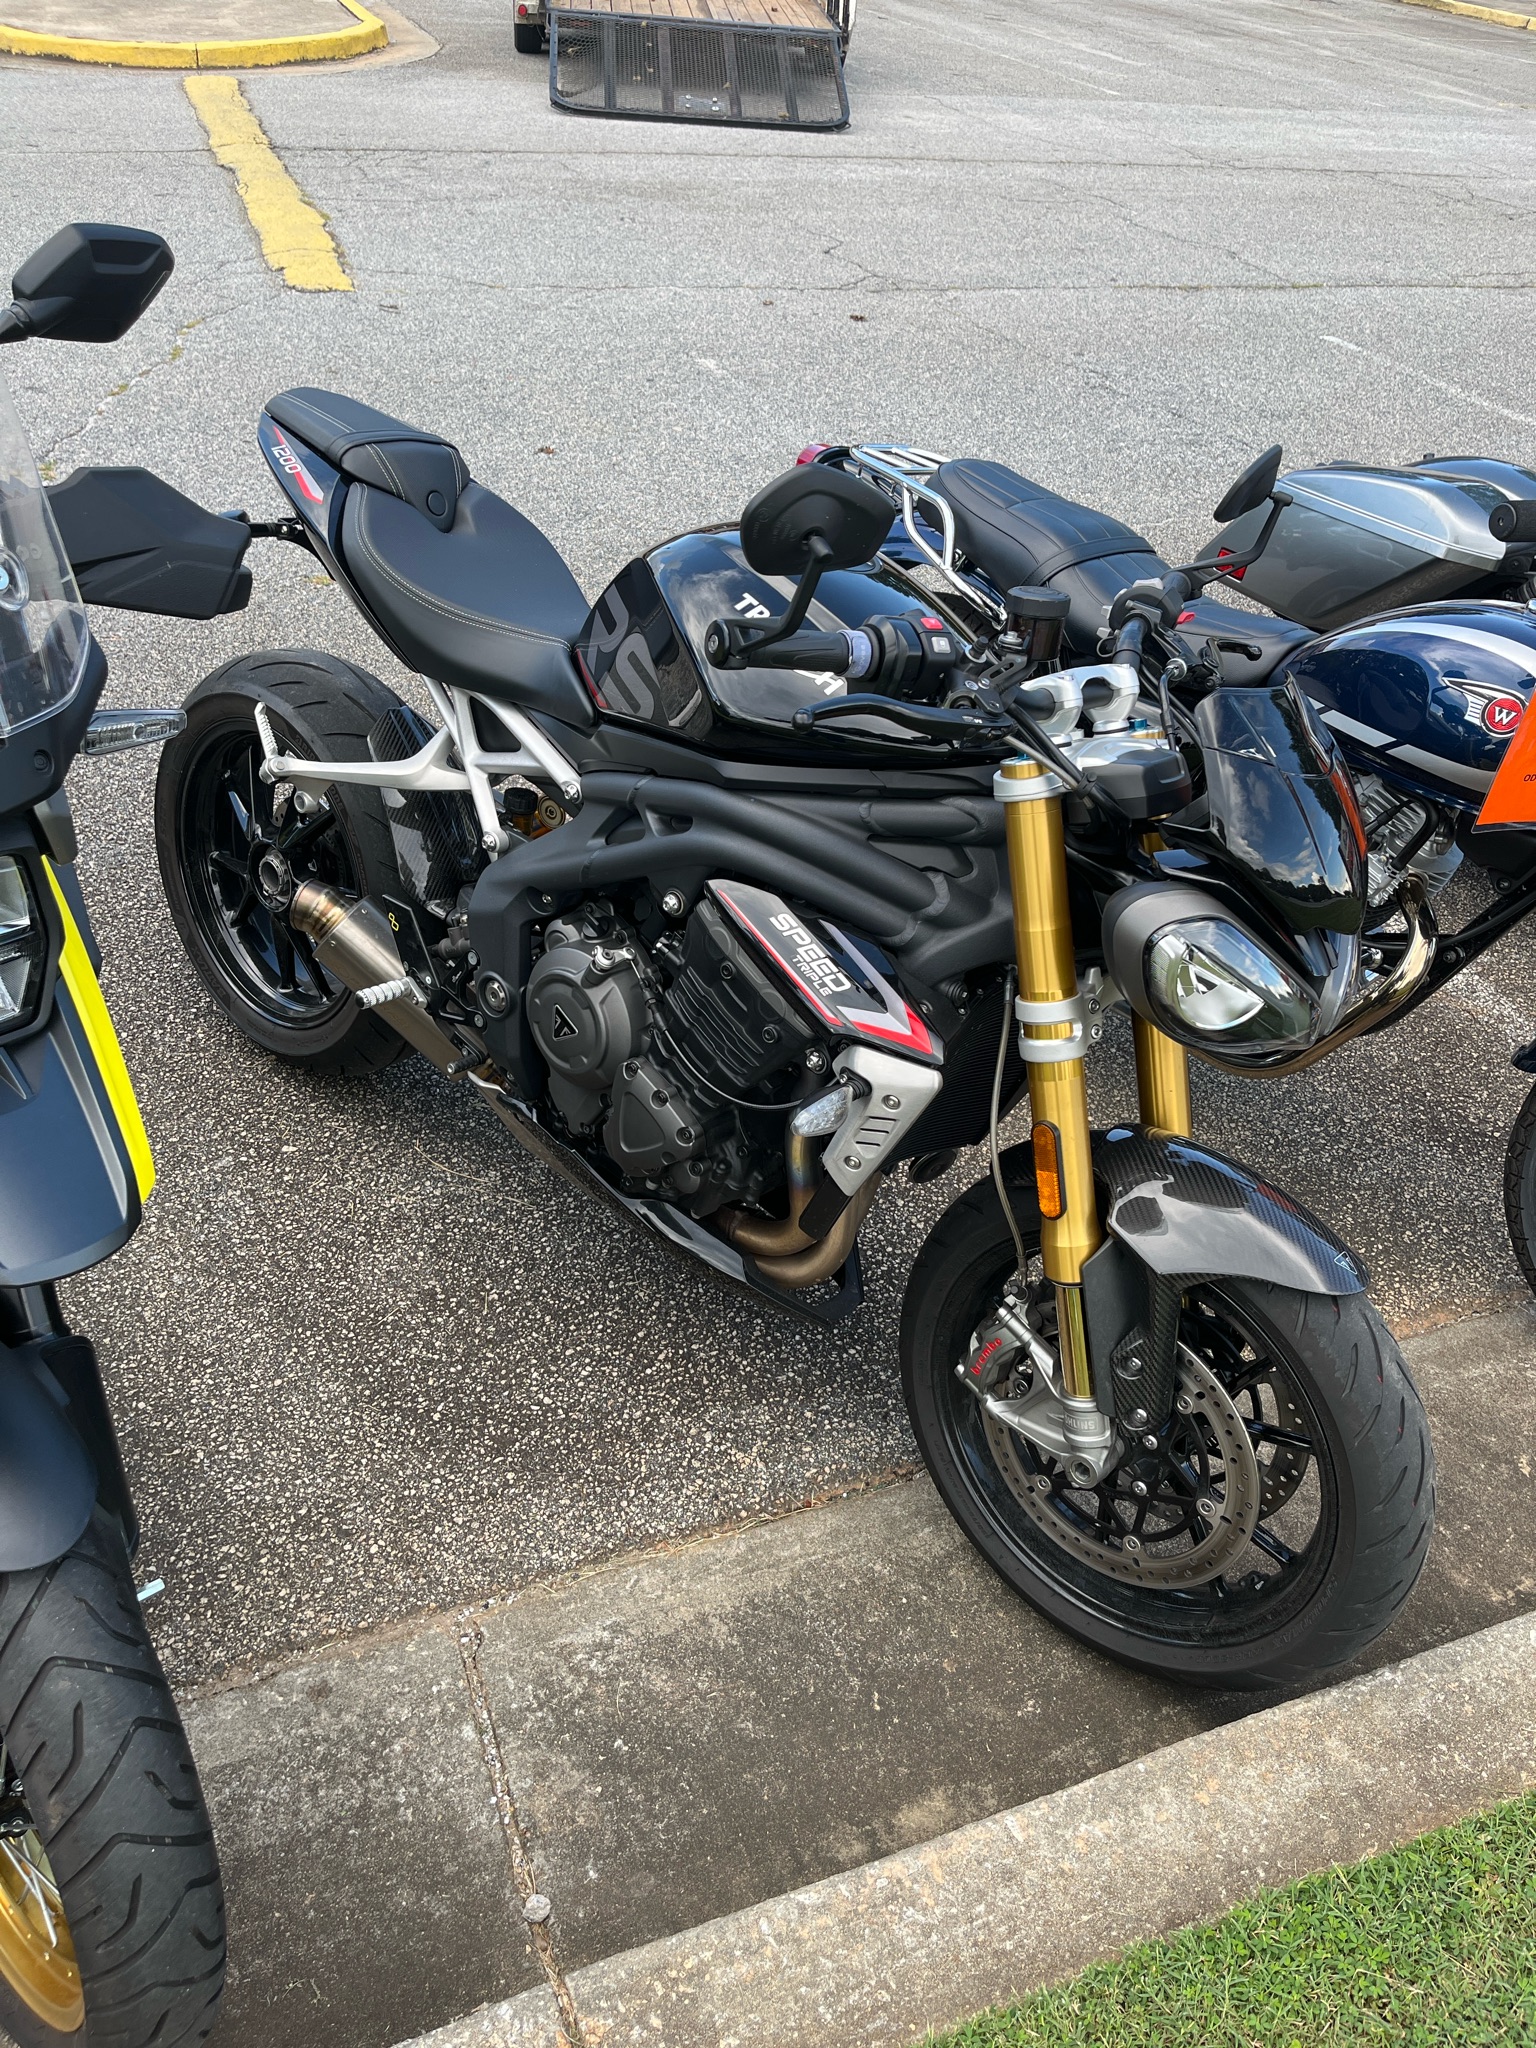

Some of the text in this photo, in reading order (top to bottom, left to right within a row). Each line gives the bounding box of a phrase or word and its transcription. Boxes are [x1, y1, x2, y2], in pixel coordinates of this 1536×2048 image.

[270, 444, 302, 474] 1200
[1494, 706, 1517, 726] W
[769, 913, 852, 992] SPEED
[792, 954, 833, 997] TRIPLE
[970, 1337, 1003, 1375] brembo
